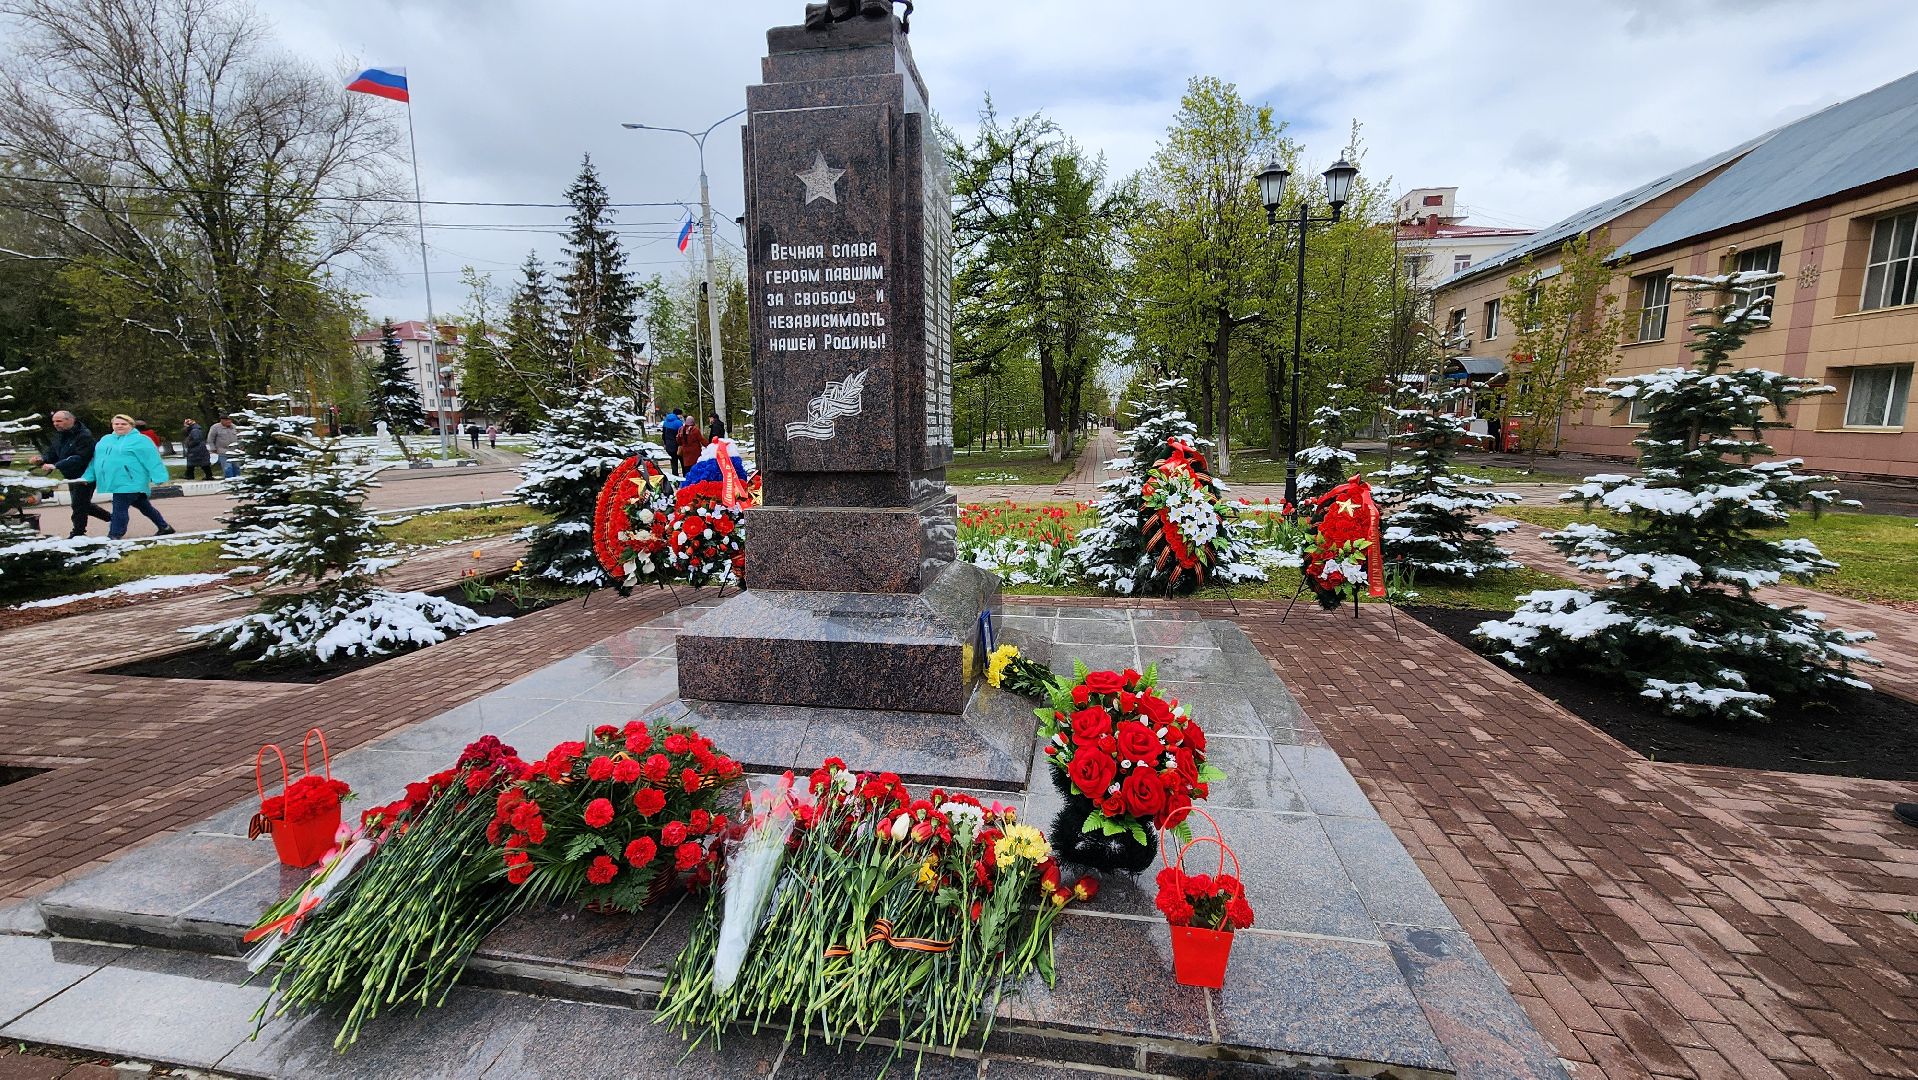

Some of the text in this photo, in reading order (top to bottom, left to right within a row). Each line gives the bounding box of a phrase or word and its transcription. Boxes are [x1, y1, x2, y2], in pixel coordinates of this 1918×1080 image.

[771, 242, 877, 260] ВЕЧНАЯ СЛАВА
[766, 266, 883, 284] ГЕРОЯМ ПАВШИМ
[767, 289, 884, 306] ЗА СВОБОДУ И
[769, 312, 885, 328] НЕЗАВИСИМОСТЬ
[770, 333, 886, 351] НАШЕЙ РОДИНЫ!
